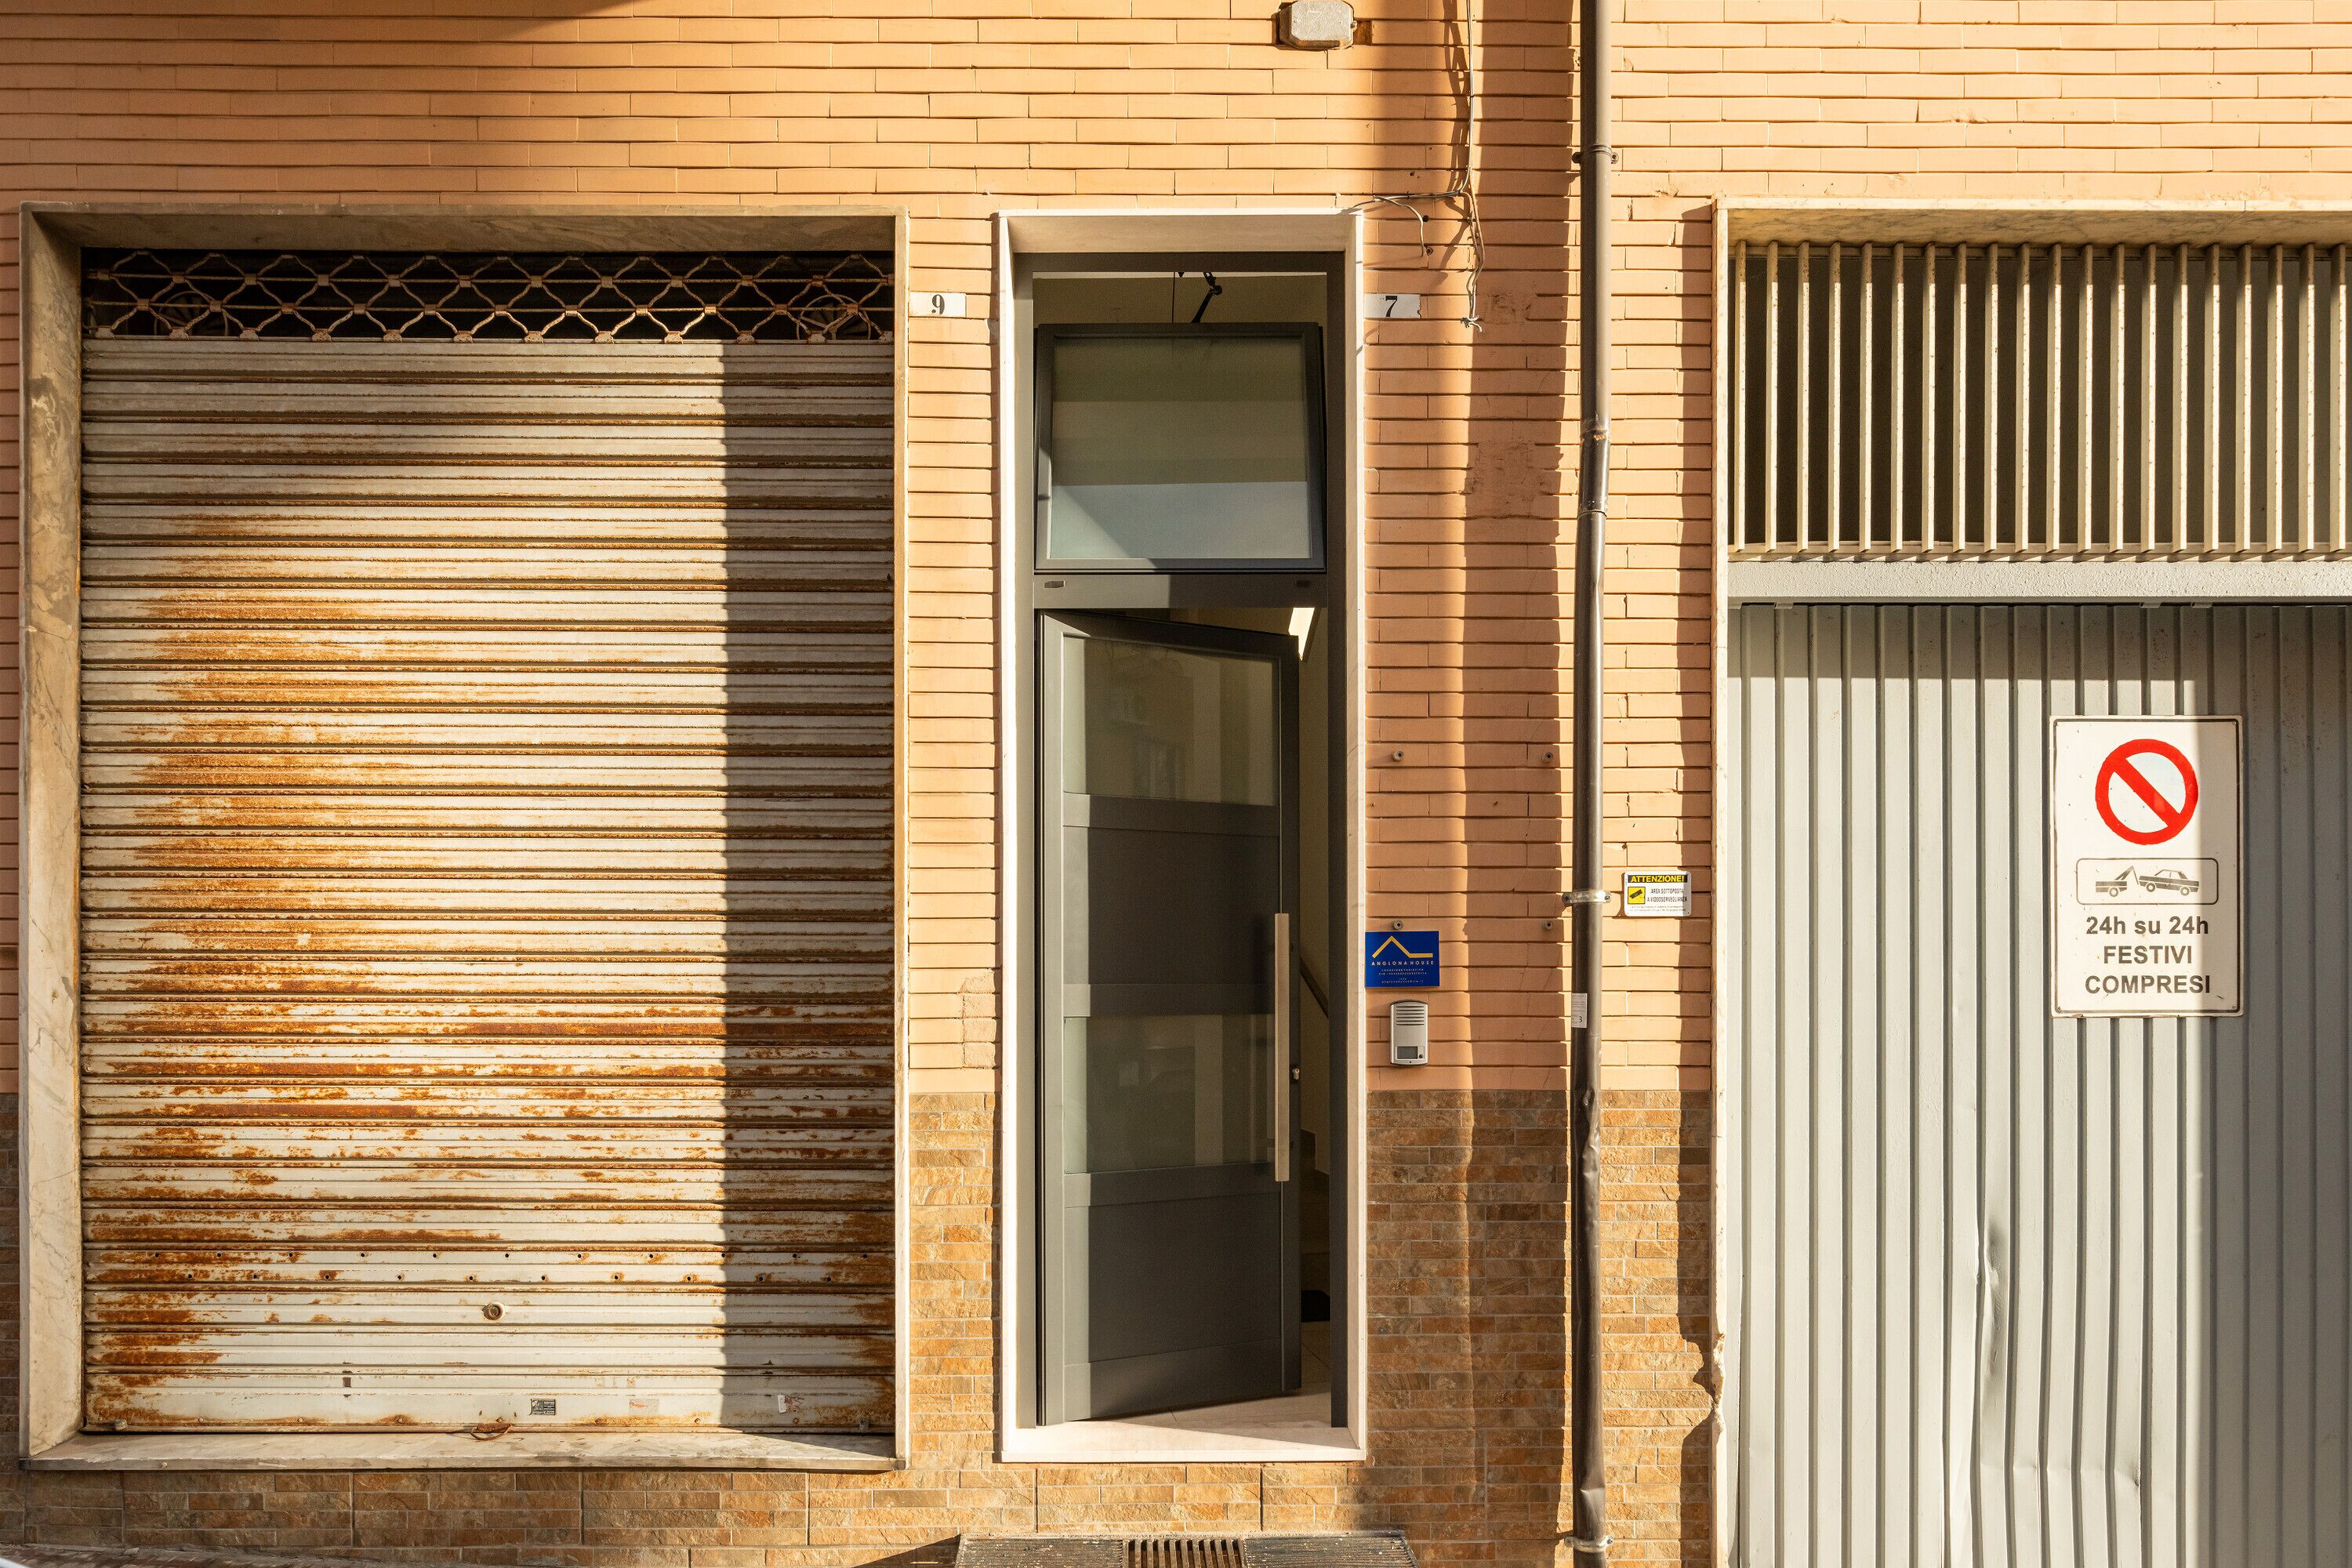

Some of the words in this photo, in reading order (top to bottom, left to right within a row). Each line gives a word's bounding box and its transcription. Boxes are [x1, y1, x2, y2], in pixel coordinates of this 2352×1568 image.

[931, 294, 945, 315] 9
[1385, 296, 1397, 317] 7
[2086, 916, 2125, 934] 24h
[2134, 920, 2160, 934] su
[2169, 916, 2209, 934] 24h
[2103, 946, 2192, 964] FESTIVI
[2085, 975, 2209, 993] COMPRESI
